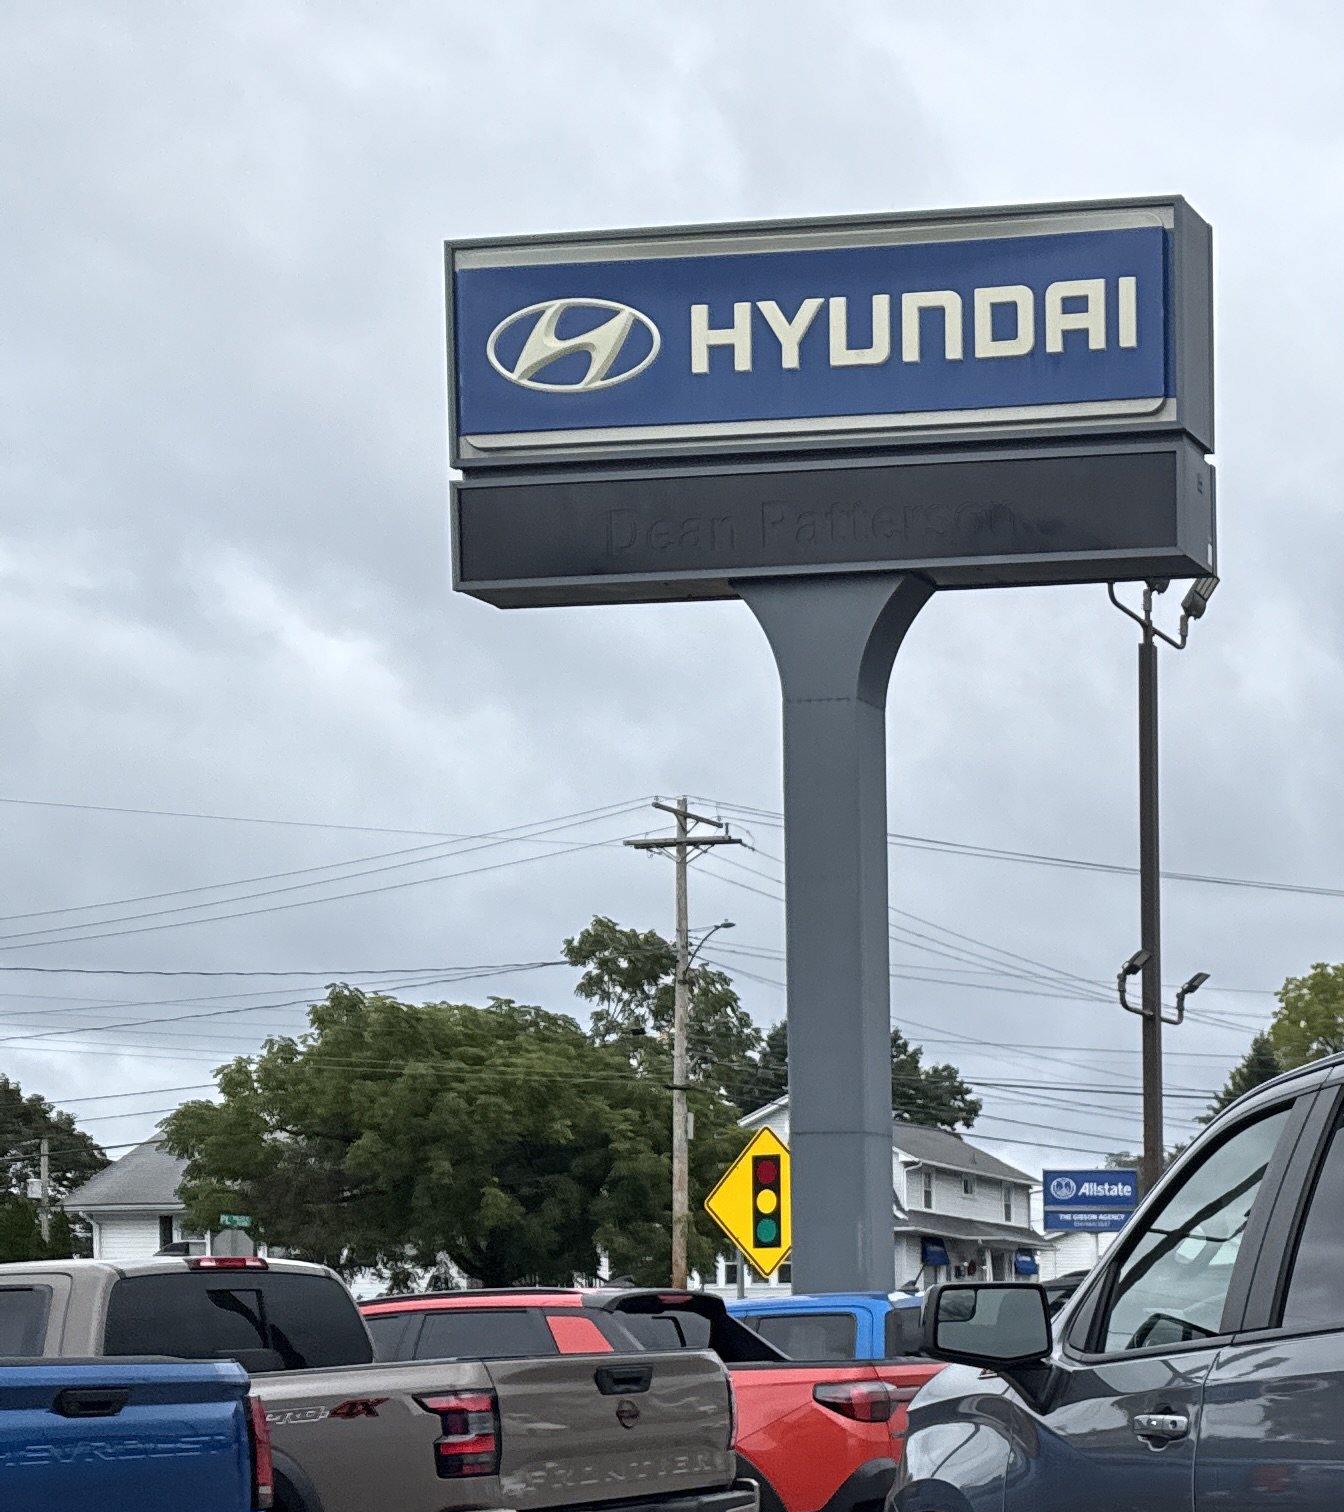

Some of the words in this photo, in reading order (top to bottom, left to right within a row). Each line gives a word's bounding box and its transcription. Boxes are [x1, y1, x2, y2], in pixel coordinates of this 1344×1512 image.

[691, 275, 1138, 375] HYUNDAI
[604, 507, 737, 556] Dean
[761, 500, 1018, 548] Patterson
[1078, 1182, 1132, 1197] Allstate
